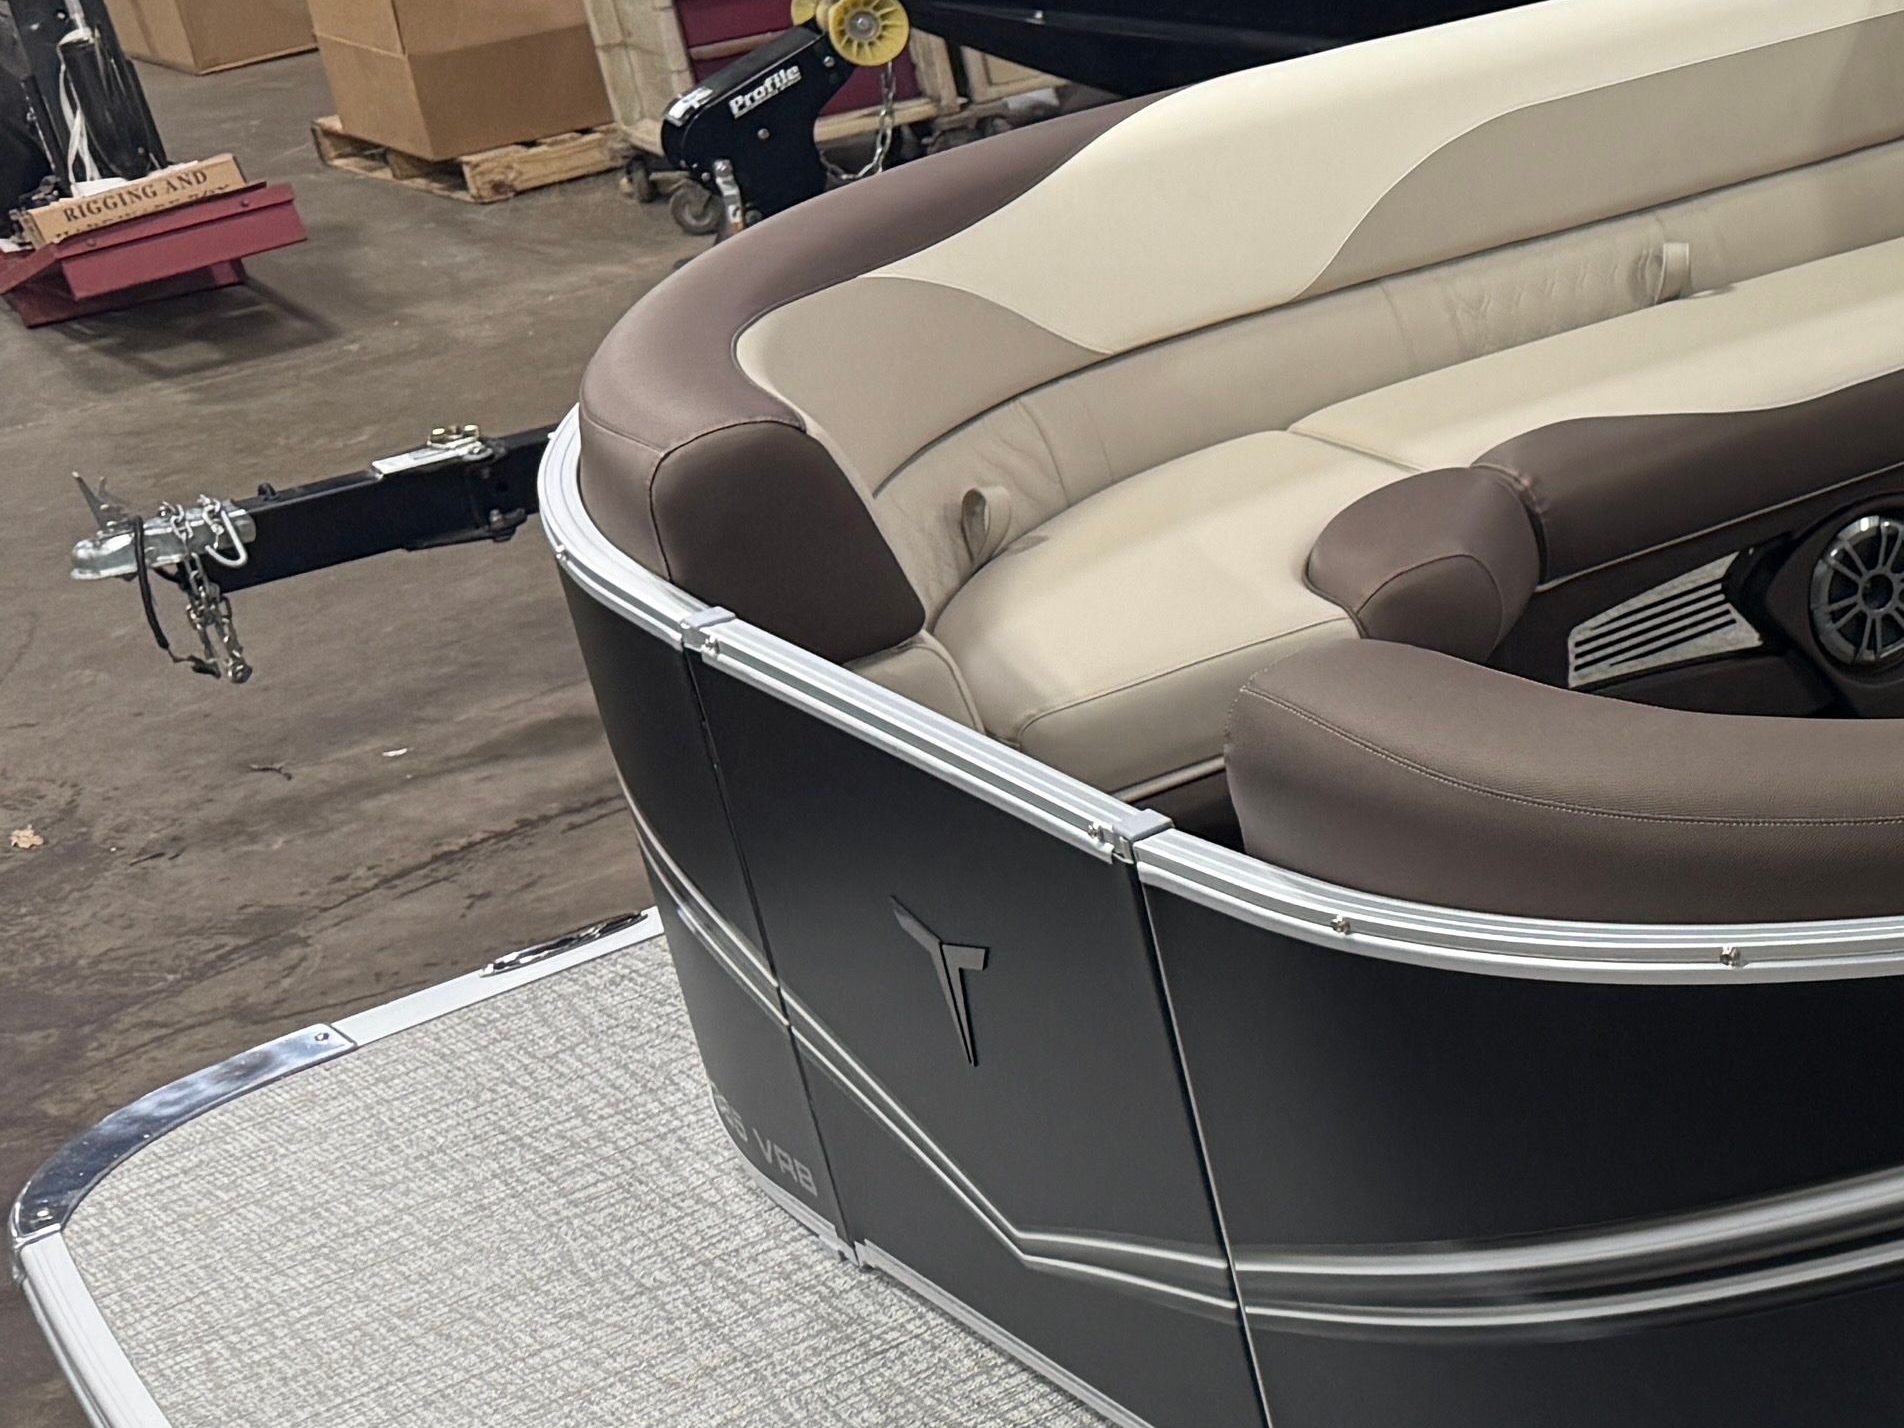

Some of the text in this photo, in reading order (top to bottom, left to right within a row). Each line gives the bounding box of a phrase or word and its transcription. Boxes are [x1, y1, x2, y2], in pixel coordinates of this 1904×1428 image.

[728, 65, 802, 117] Profile
[63, 183, 159, 224] RIGGING
[164, 170, 209, 195] AND
